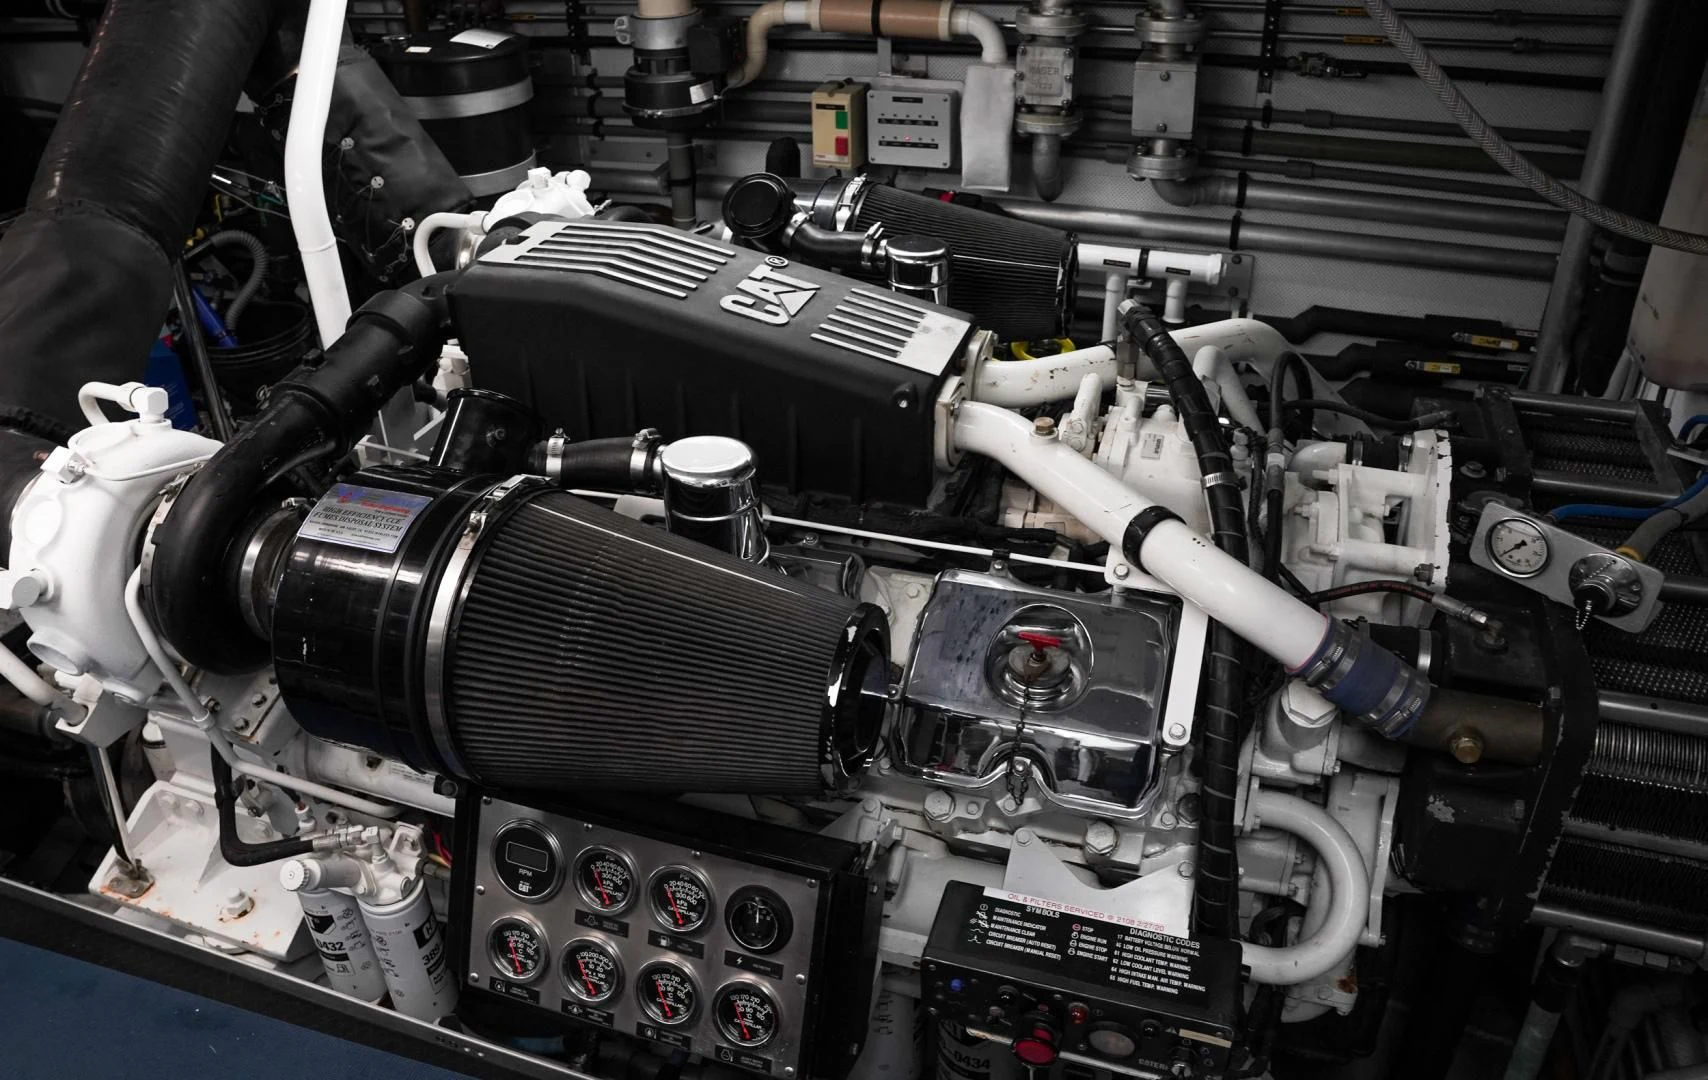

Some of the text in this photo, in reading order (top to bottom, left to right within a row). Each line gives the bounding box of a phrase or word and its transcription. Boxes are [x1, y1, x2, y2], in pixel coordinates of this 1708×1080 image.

[313, 511, 339, 522] FUMES
[339, 515, 375, 528] DISPOSAL
[374, 521, 404, 532] SYSTEM
[322, 506, 341, 516] HIGH
[341, 509, 386, 522] EFFICIENCY
[518, 868, 533, 878] RPM
[994, 907, 1022, 917] DIAGNOSTIC
[1007, 893, 1020, 901] OIL
[1030, 897, 1062, 910] FILTERS
[1064, 903, 1105, 919] SERVICED
[990, 923, 1036, 937] MAINTENANCE CLEAR
[992, 915, 1047, 931] MAINTENANCE INDICATOR
[986, 939, 1004, 947] CIRCUIT
[1004, 943, 1024, 952] BREAKER
[988, 931, 1006, 939] CIRCUIT
[1006, 934, 1026, 944] BREAKER
[1080, 933, 1097, 942] ENGINE
[1130, 928, 1200, 949] DIAGNOSTIC CODES
[1078, 941, 1108, 953] ENGINE STOP
[1124, 936, 1144, 945] BATTERY
[1144, 940, 1164, 949] VOLTAGE
[1164, 944, 1180, 952] BELOW
[1180, 948, 1200, 957] NORMAL
[1076, 950, 1108, 962] ENGINE START
[1134, 954, 1155, 964] COOLANT
[1169, 962, 1191, 972] WARNING
[1142, 948, 1167, 958] PRESSURE
[1167, 952, 1188, 963] WARNING
[1132, 962, 1153, 972] COOLANT
[1153, 967, 1167, 975] LEVEL
[1167, 970, 1189, 980] WARNING
[1117, 976, 1129, 984] HIGH
[1129, 979, 1142, 987] FUEL
[1156, 984, 1179, 994] WARNING
[1131, 970, 1147, 979] INTAKE
[1183, 982, 1206, 992] WARNING
